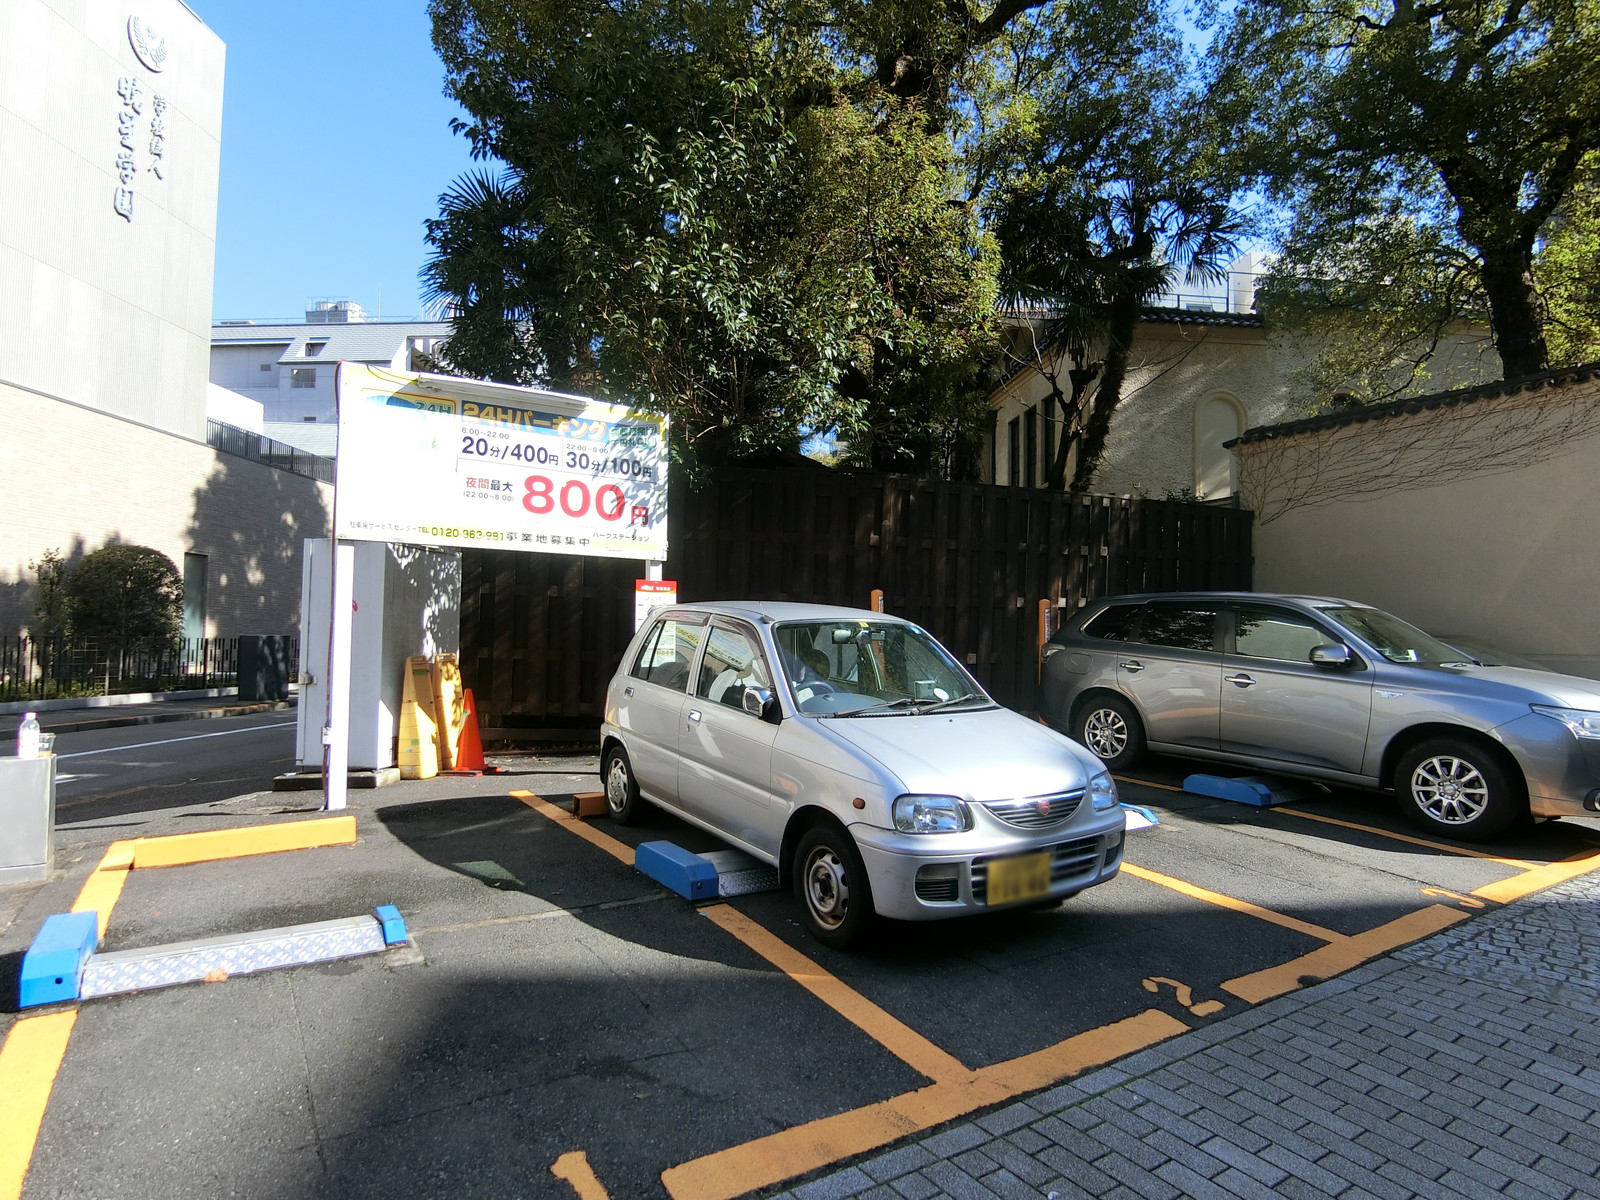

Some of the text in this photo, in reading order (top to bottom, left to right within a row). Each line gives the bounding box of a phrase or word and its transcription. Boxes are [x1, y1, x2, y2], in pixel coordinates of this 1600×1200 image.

[415, 401, 453, 416] 24H
[463, 403, 607, 441] 24Hパーキング
[461, 435, 559, 466] 20分/400円
[565, 450, 652, 478] 30分/100円
[465, 477, 514, 493] 夜間最大
[522, 475, 649, 526] 800円
[506, 531, 590, 547] 事業地募集中
[1142, 976, 1226, 1018] 2
